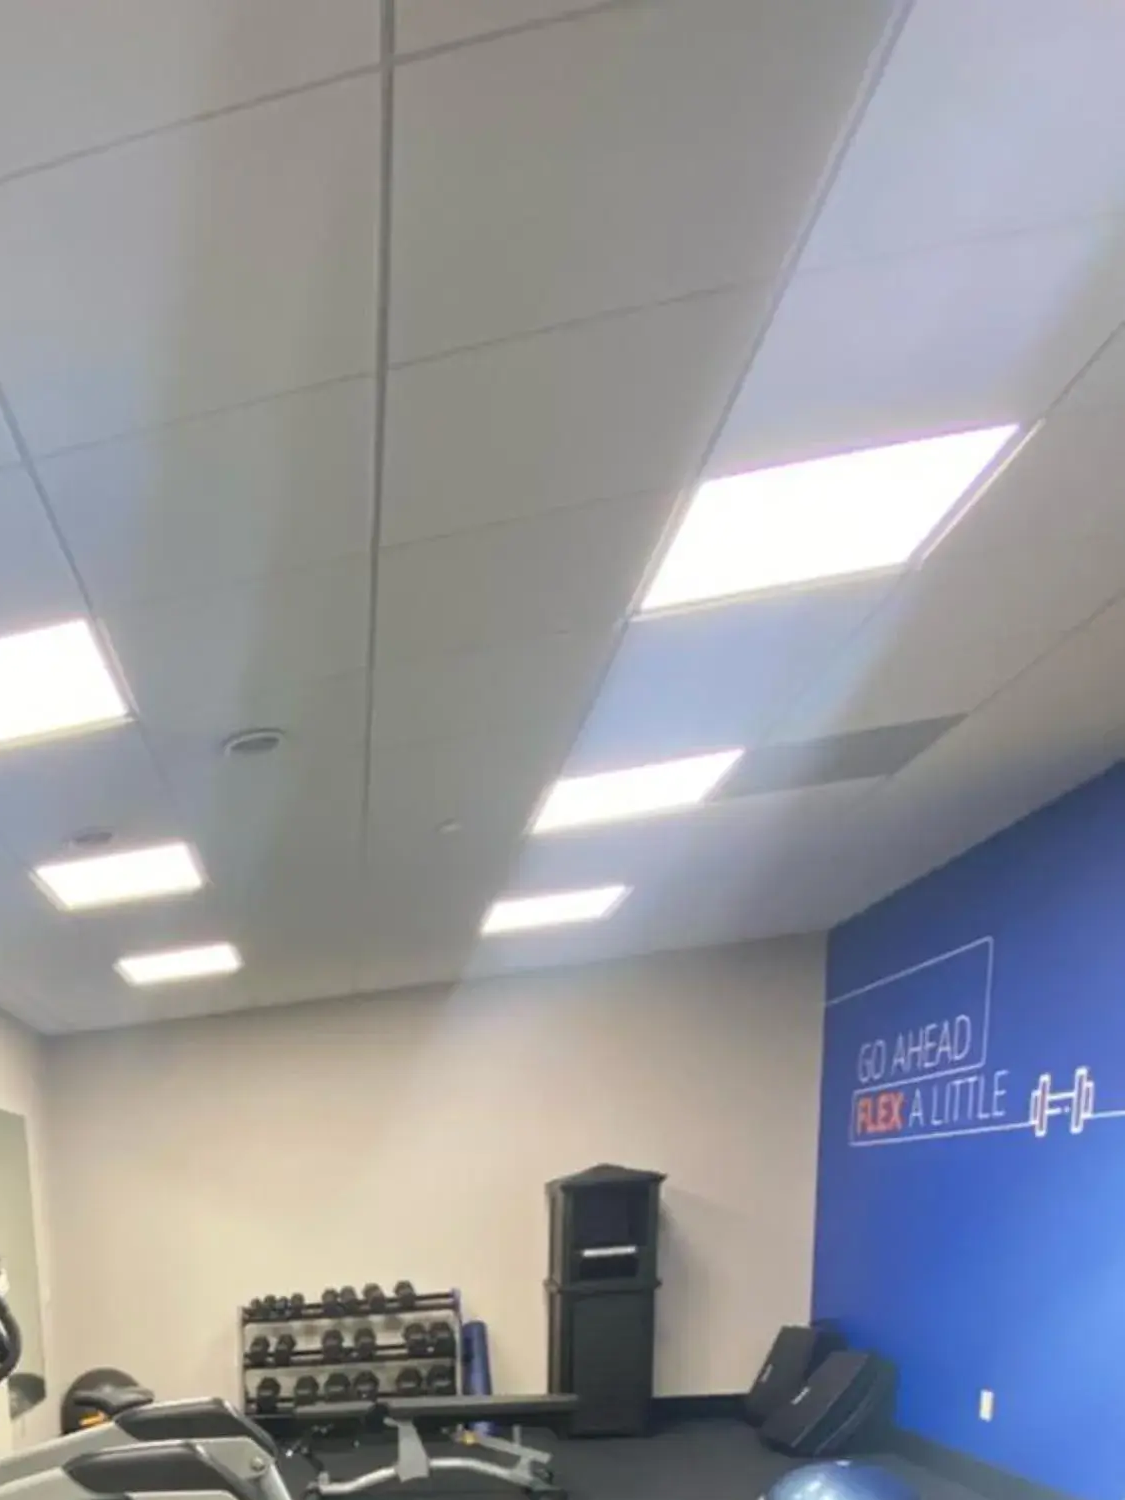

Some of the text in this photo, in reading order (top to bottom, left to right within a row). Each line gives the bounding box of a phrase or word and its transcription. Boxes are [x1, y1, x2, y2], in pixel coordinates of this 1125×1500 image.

[858, 1014, 971, 1083] GO AHEAD
[856, 1070, 1009, 1136] FLEX A LITTLE
